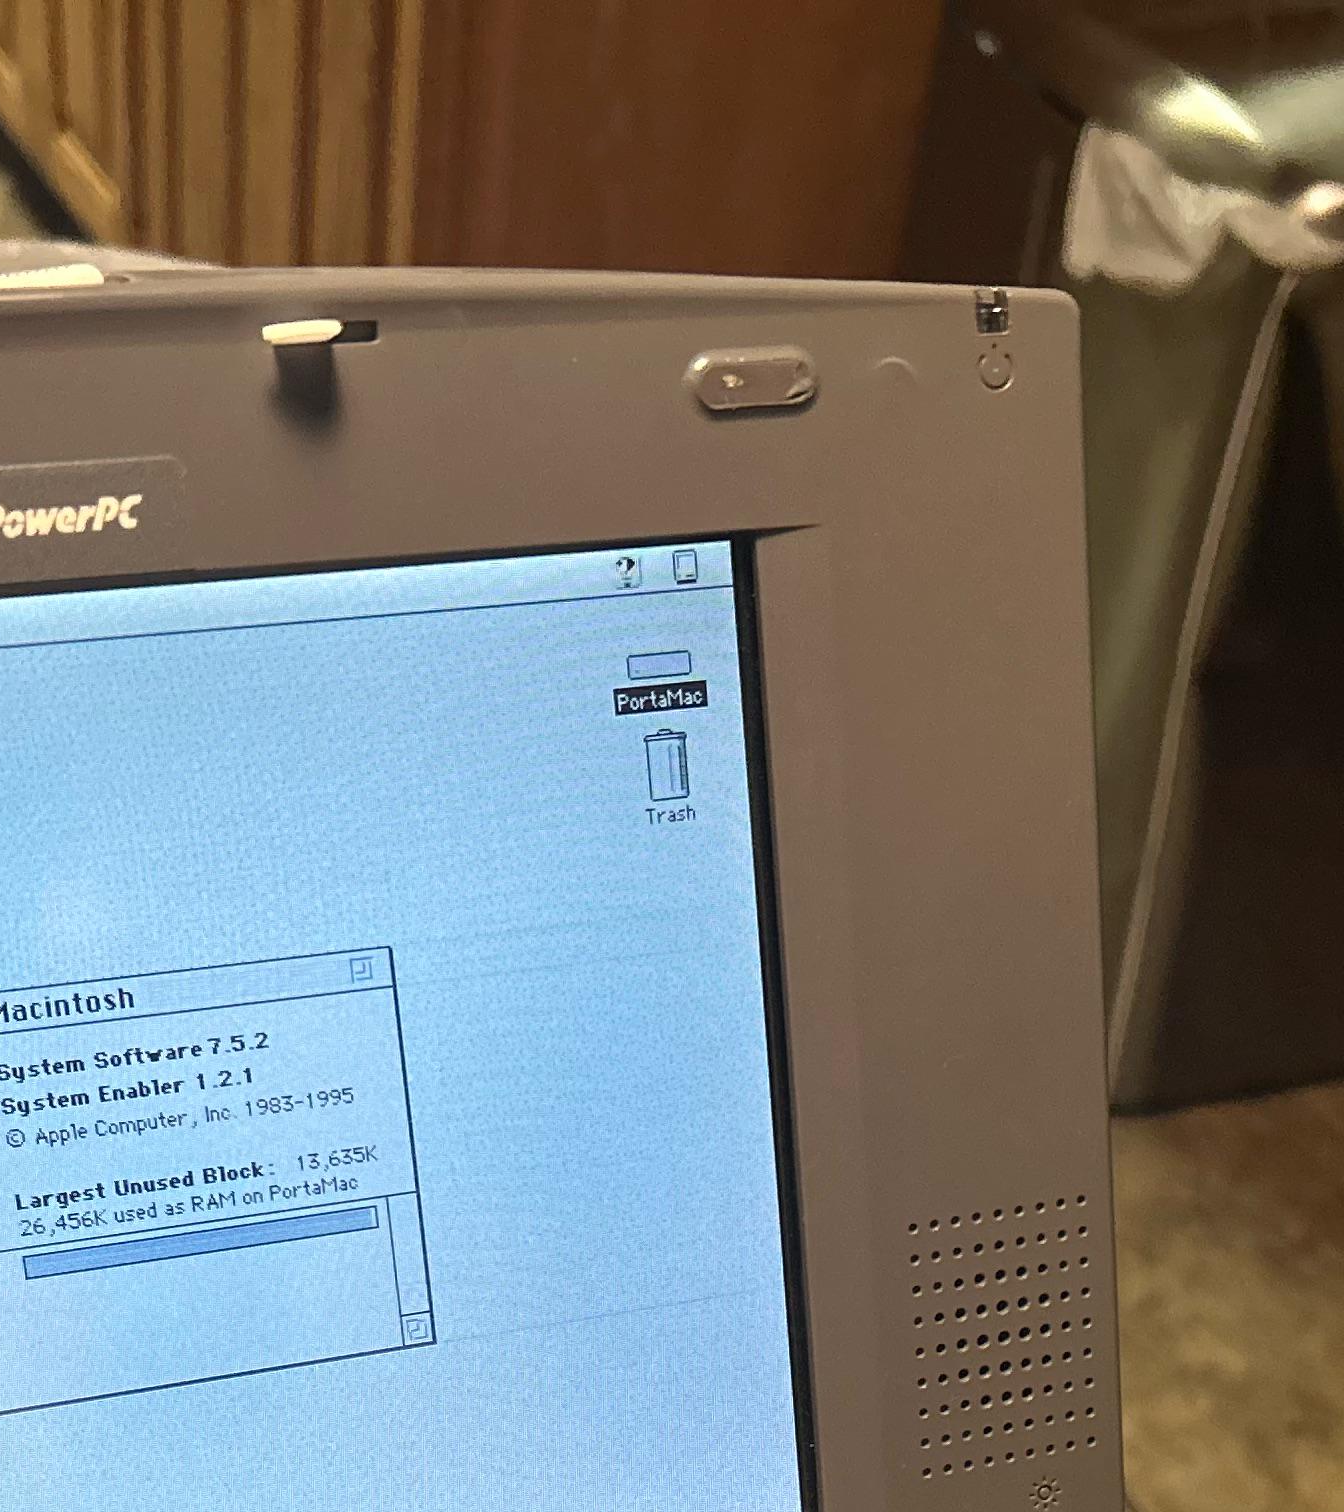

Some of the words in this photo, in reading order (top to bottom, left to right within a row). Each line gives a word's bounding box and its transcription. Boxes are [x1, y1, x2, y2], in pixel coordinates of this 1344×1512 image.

[616, 688, 704, 713] PortaMac
[645, 805, 696, 825] Trash
[94, 1042, 202, 1070] Software
[206, 1031, 270, 1056] 7.5.2
[0, 1092, 90, 1118] System
[98, 1078, 184, 1104] Enabler
[195, 1067, 254, 1092] 1.2.1
[35, 1118, 88, 1148] Apple
[205, 1104, 238, 1123] Inc.
[245, 1086, 355, 1118] 1983-1995
[14, 1182, 106, 1212] Largest
[114, 1171, 194, 1197] Unused
[296, 1145, 379, 1174] 13,635K
[19, 1209, 108, 1241] 26,456K
[114, 1202, 158, 1225] used
[165, 1199, 185, 1217] as
[190, 1191, 237, 1214] RAM
[242, 1188, 265, 1206] on
[269, 1176, 359, 1201] PortaMac
